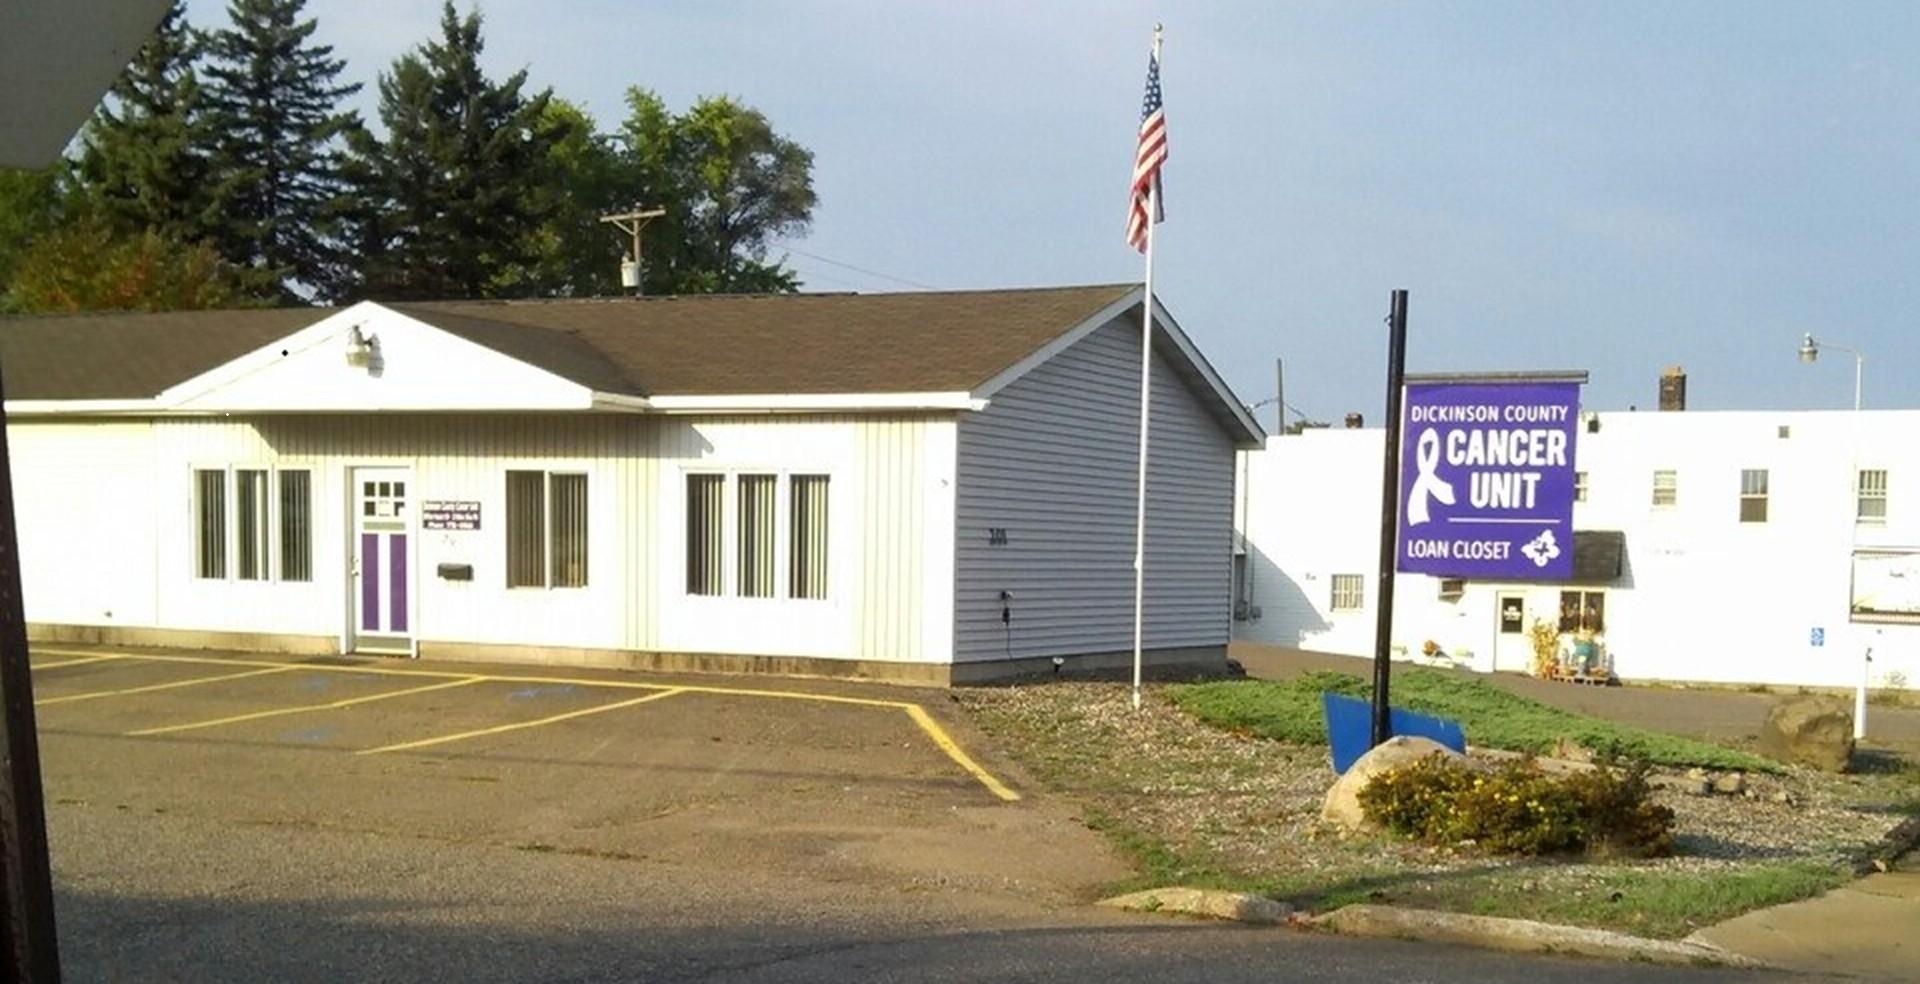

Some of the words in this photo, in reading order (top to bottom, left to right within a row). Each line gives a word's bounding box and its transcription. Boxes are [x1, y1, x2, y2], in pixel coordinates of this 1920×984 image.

[1411, 405, 1499, 422] DICKINSON
[1504, 405, 1568, 422] COUNTY
[1446, 428, 1567, 466] CANCER
[1470, 471, 1541, 509] UNIT
[1407, 539, 1449, 559] LOAN
[1453, 540, 1511, 560] CLOSET
